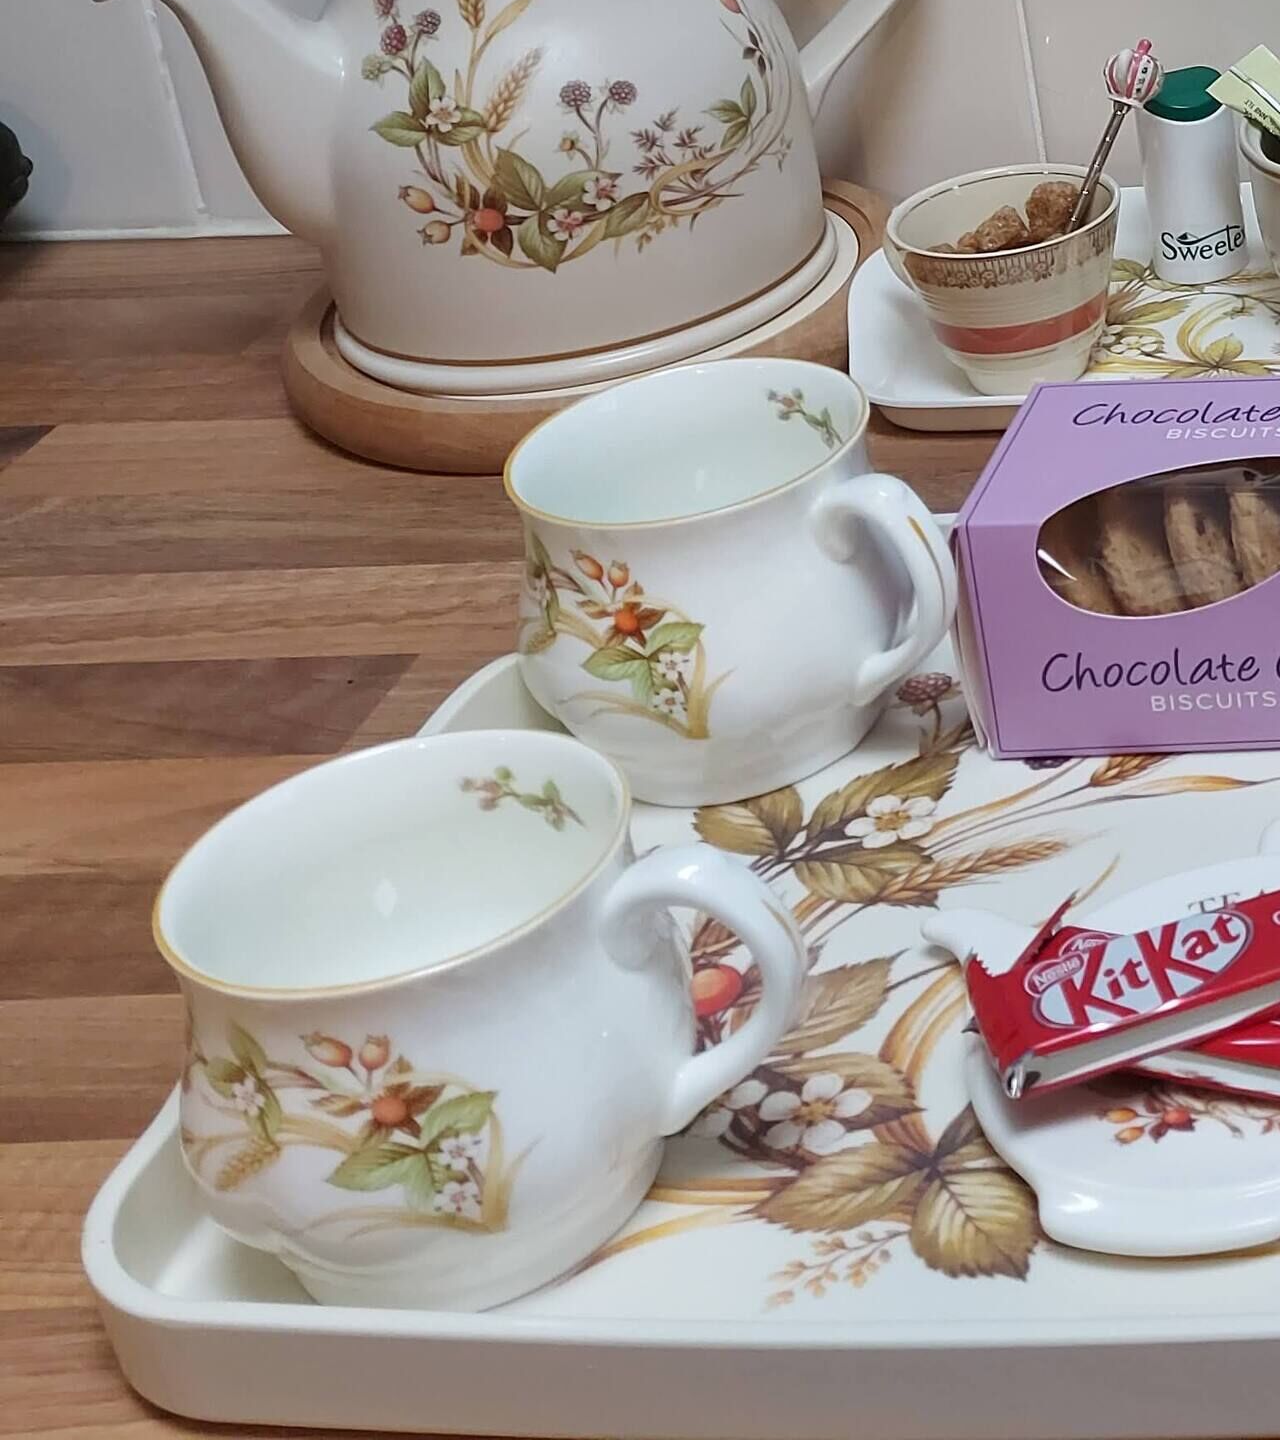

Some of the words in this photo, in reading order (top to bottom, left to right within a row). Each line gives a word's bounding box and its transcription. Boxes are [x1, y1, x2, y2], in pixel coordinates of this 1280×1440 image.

[1160, 224, 1246, 261] Sweete
[1041, 647, 1261, 692] Chocolate
[1150, 691, 1278, 712] BISCUITS
